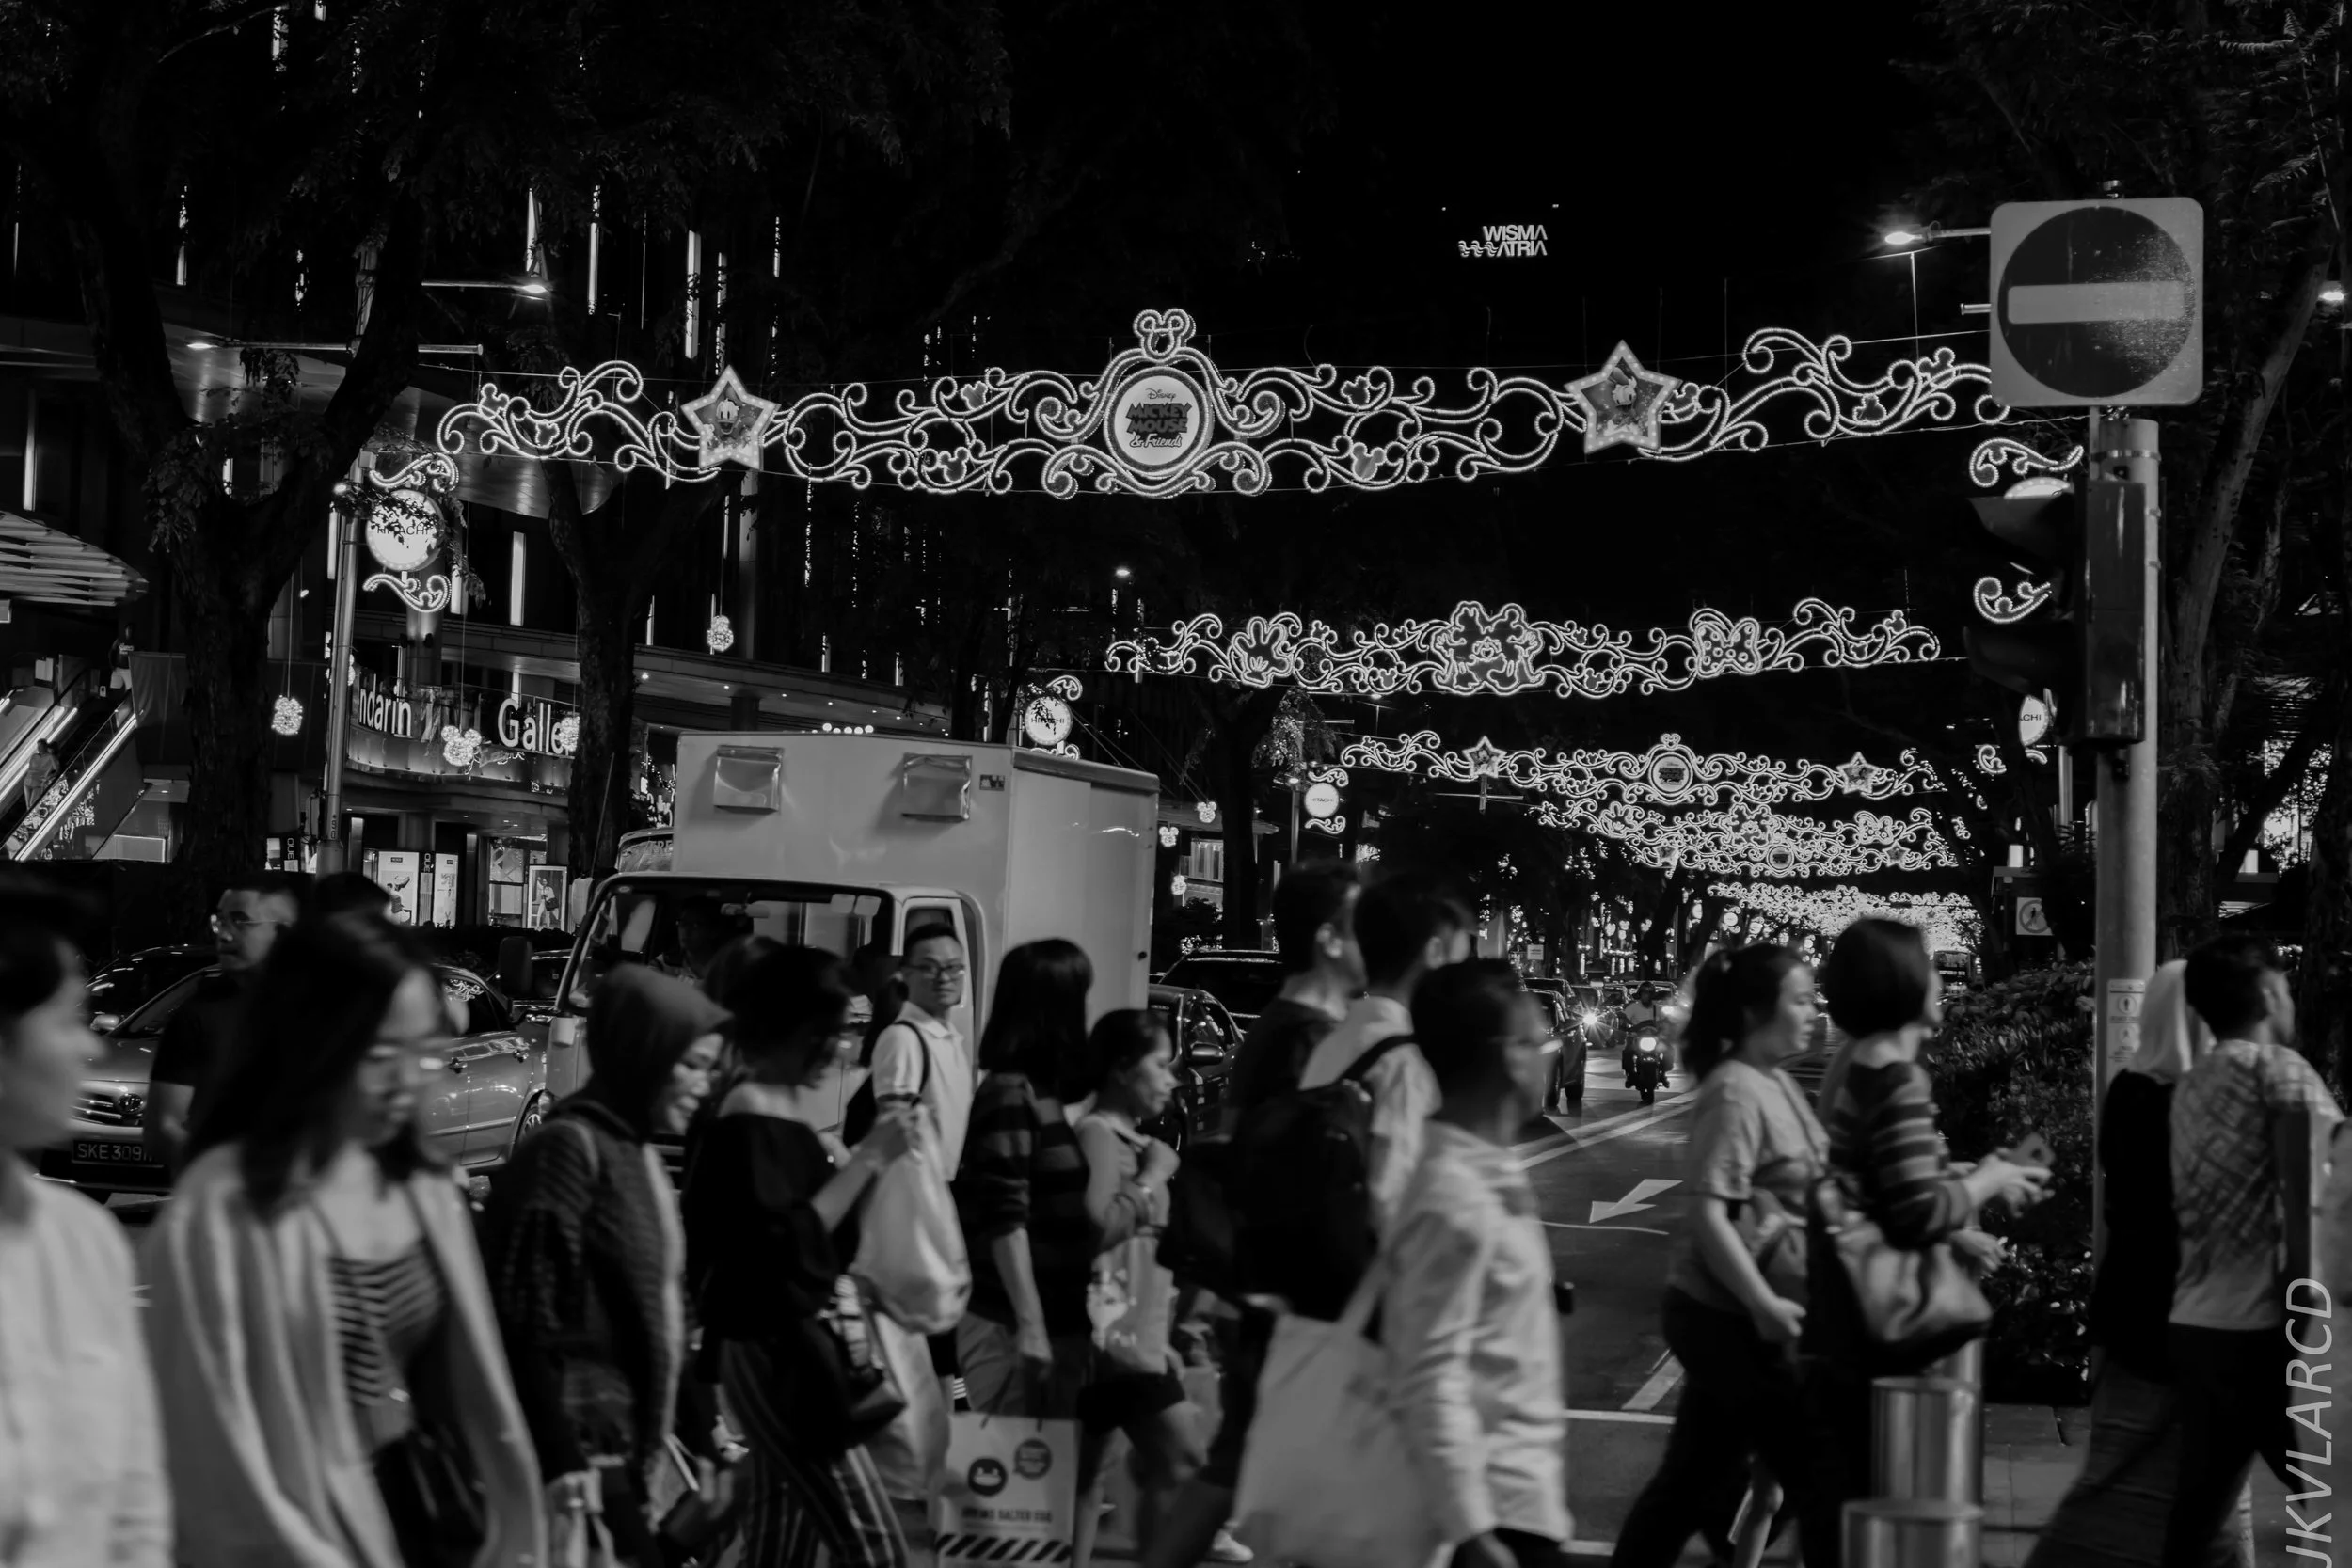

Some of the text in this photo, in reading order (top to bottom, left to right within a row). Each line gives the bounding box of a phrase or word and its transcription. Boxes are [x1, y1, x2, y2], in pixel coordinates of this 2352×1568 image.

[1483, 225, 1548, 242] WISMA
[1496, 240, 1548, 257] ATRIA
[1146, 388, 1177, 402] Disney
[1125, 402, 1193, 419] MICKEY
[1126, 418, 1188, 434] MOUSE
[1144, 432, 1183, 448] Friends
[2020, 713, 2042, 721] CHI
[77, 1143, 109, 1160] SKE
